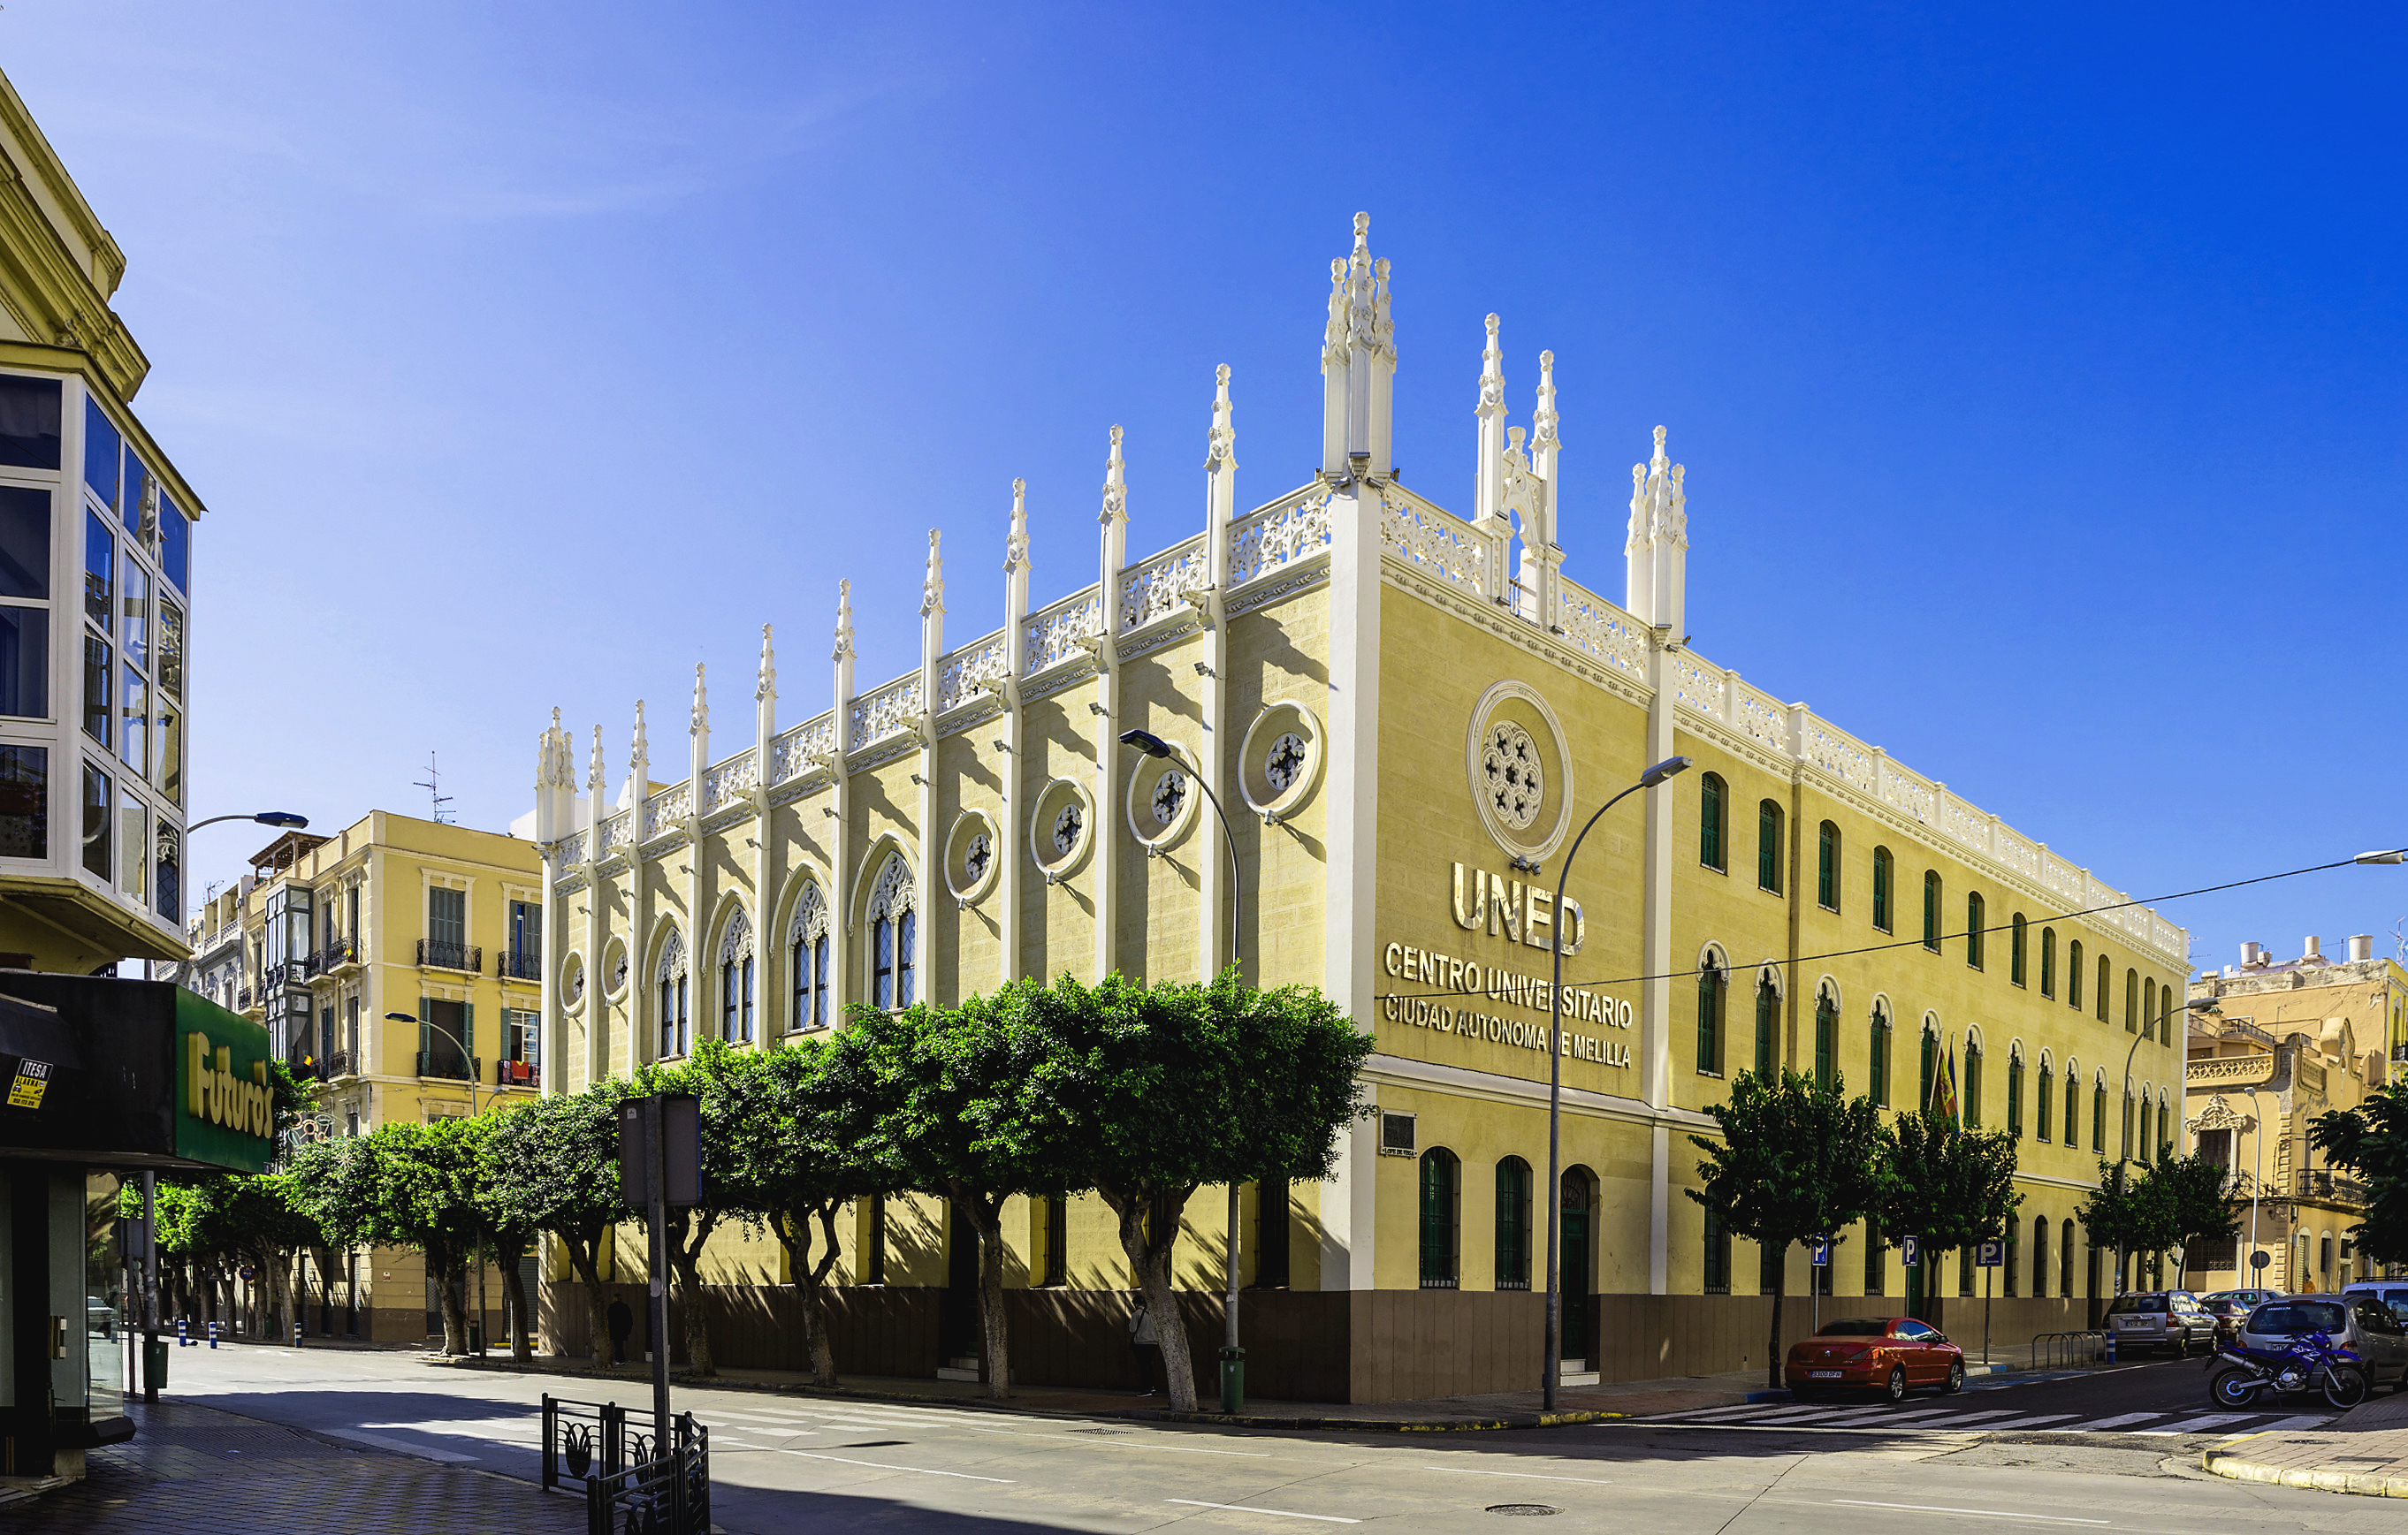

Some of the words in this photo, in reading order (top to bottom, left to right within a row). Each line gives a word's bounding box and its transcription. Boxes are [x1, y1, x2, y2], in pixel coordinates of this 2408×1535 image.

[1452, 862, 1584, 956] UNED
[1383, 942, 1481, 993] CENTRO
[1383, 992, 1452, 1032] CIUDAD
[1456, 1009, 1547, 1052] AUTONOMA
[1574, 1034, 1631, 1068] MELILLA
[22, 1061, 48, 1078] ITESA
[1906, 1239, 1915, 1263] P
[1980, 1243, 1997, 1264] P
